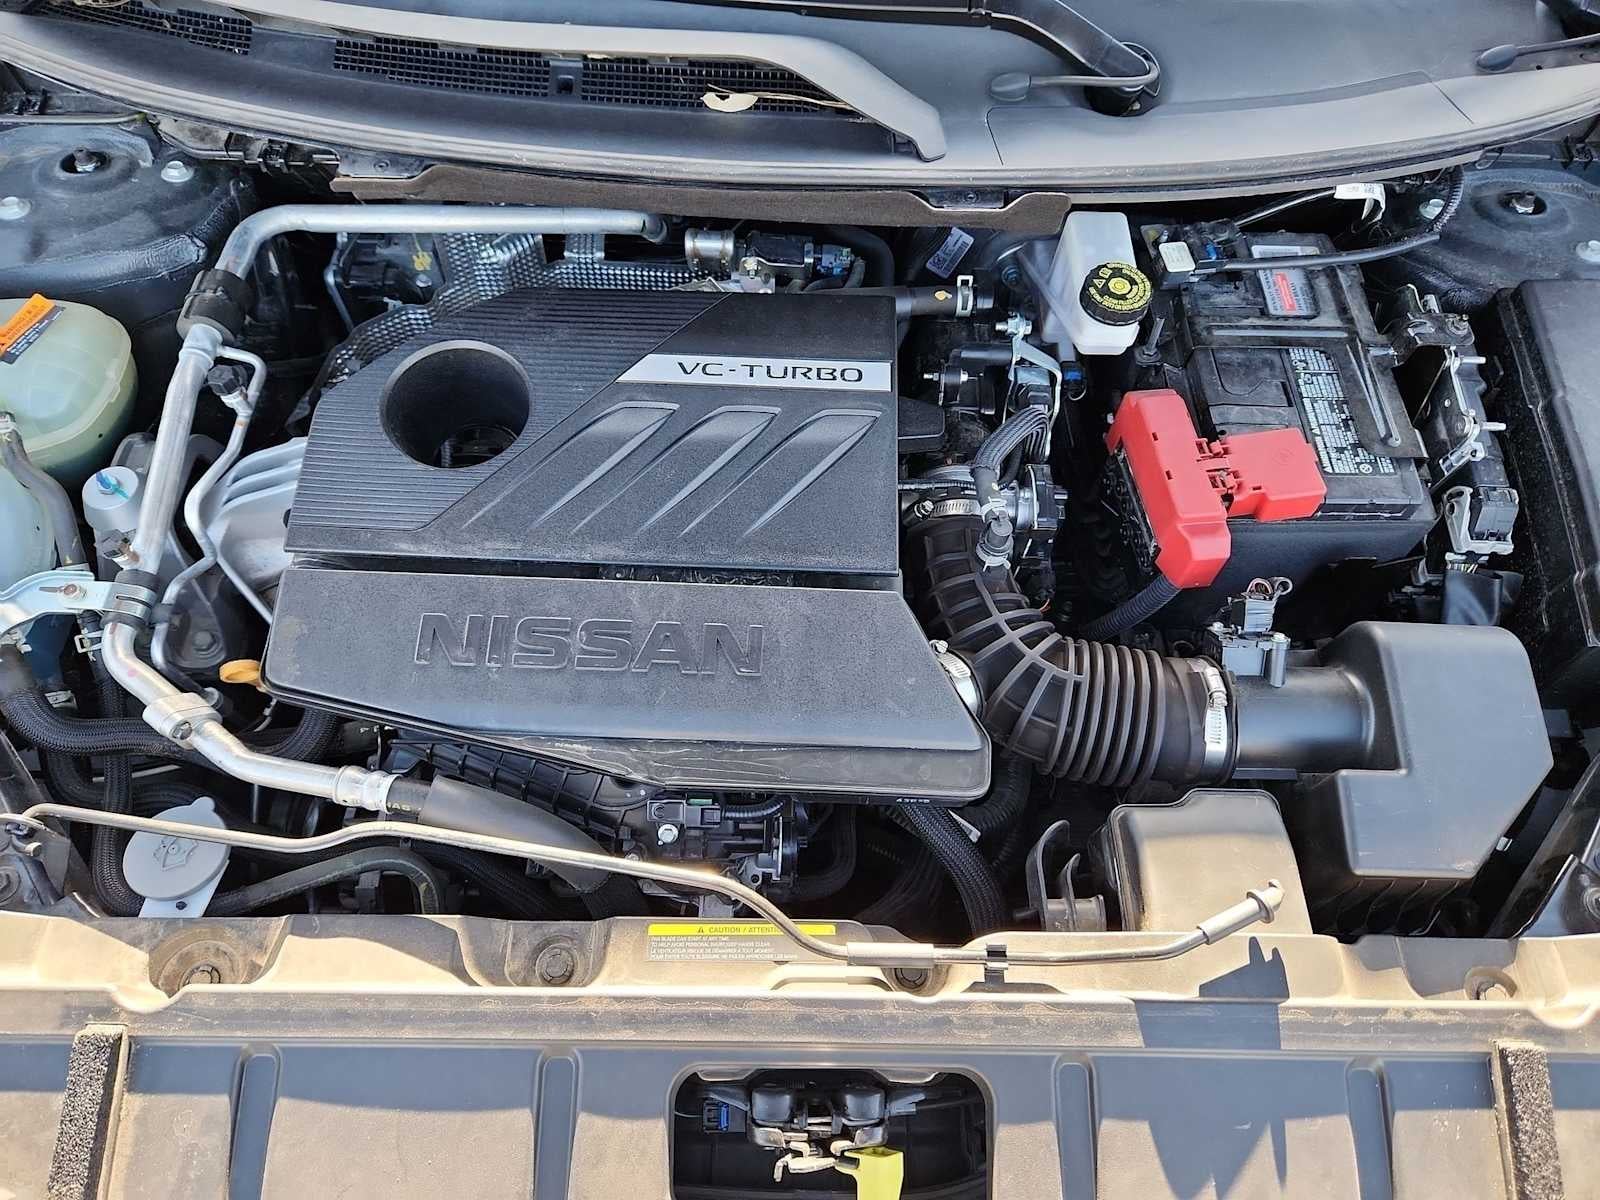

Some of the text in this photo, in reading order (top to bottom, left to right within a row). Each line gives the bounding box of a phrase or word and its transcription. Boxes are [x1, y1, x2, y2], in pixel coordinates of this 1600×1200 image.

[677, 361, 864, 383] VC-TURBO
[414, 612, 765, 677] NISSAN
[708, 926, 741, 934] CAUTION
[748, 926, 778, 934] ATTENTI
